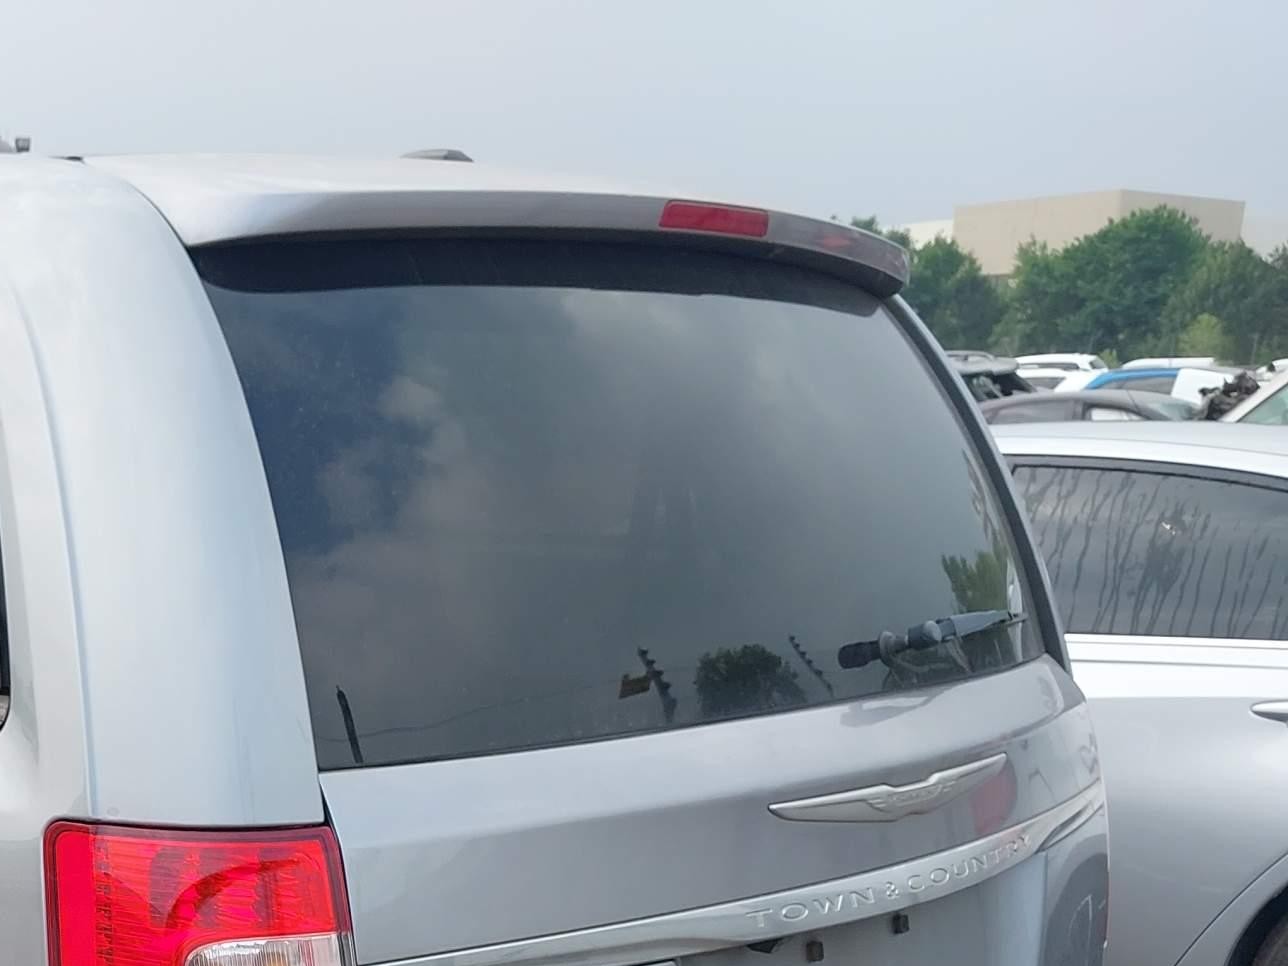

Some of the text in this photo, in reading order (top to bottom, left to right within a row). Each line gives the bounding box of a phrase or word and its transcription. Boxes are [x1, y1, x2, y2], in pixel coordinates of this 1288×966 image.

[745, 834, 1032, 928] TOWN & COUNTRY
